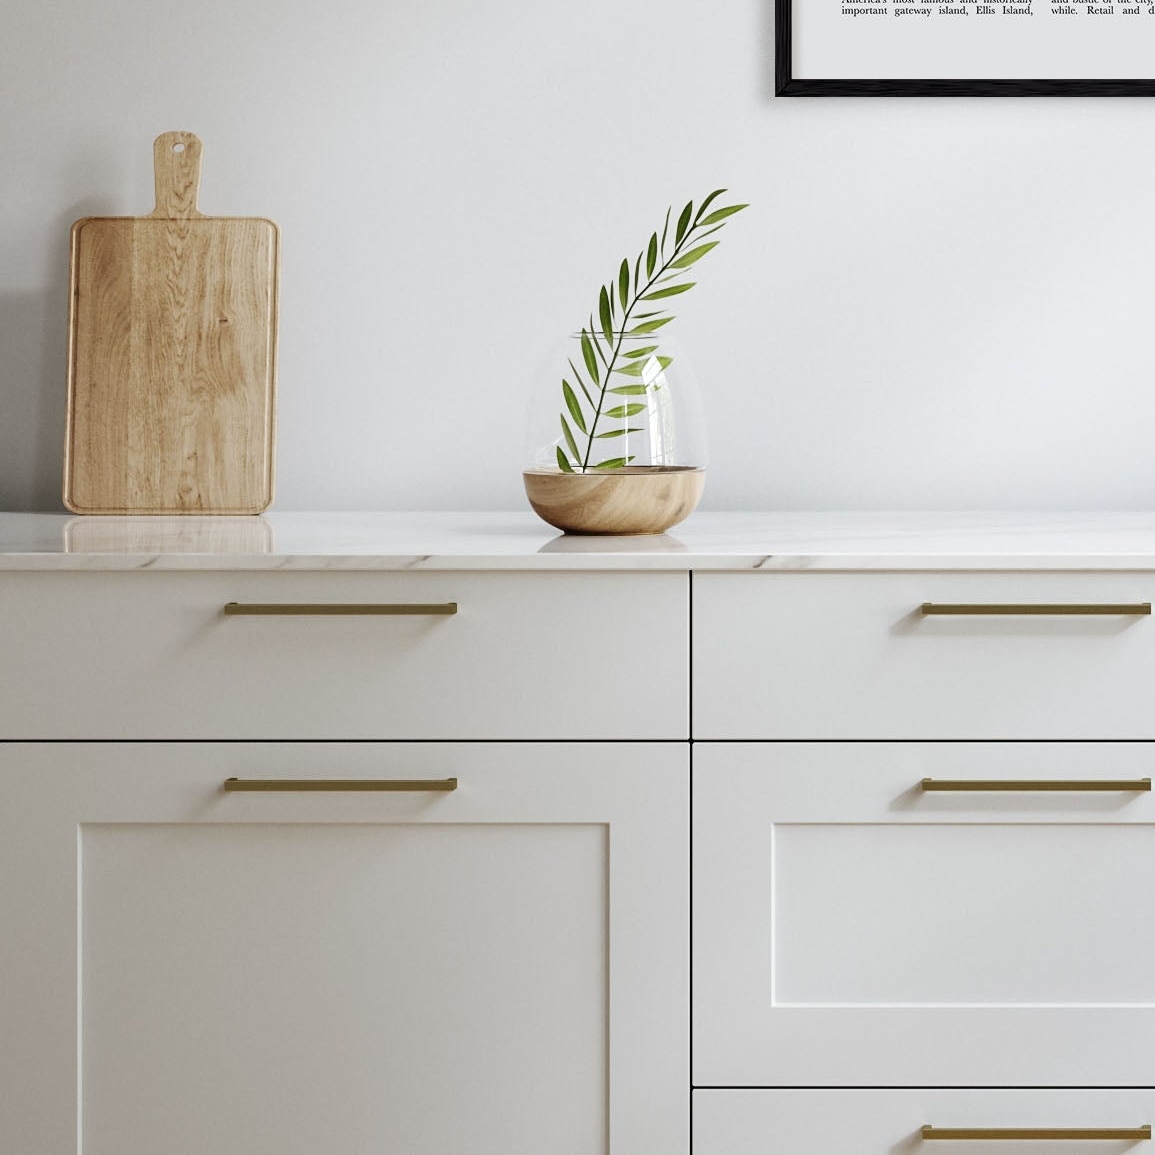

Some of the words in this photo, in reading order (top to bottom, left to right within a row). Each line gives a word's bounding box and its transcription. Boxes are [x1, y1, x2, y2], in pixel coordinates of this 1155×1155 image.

[841, 6, 888, 17] important
[894, 7, 932, 17] gateway
[939, 6, 969, 16] island,
[976, 6, 996, 14] Ellis
[1002, 6, 1033, 16] Island,
[1051, 6, 1078, 14] while.
[1087, 6, 1114, 14] Retail
[1122, 6, 1140, 14] and
